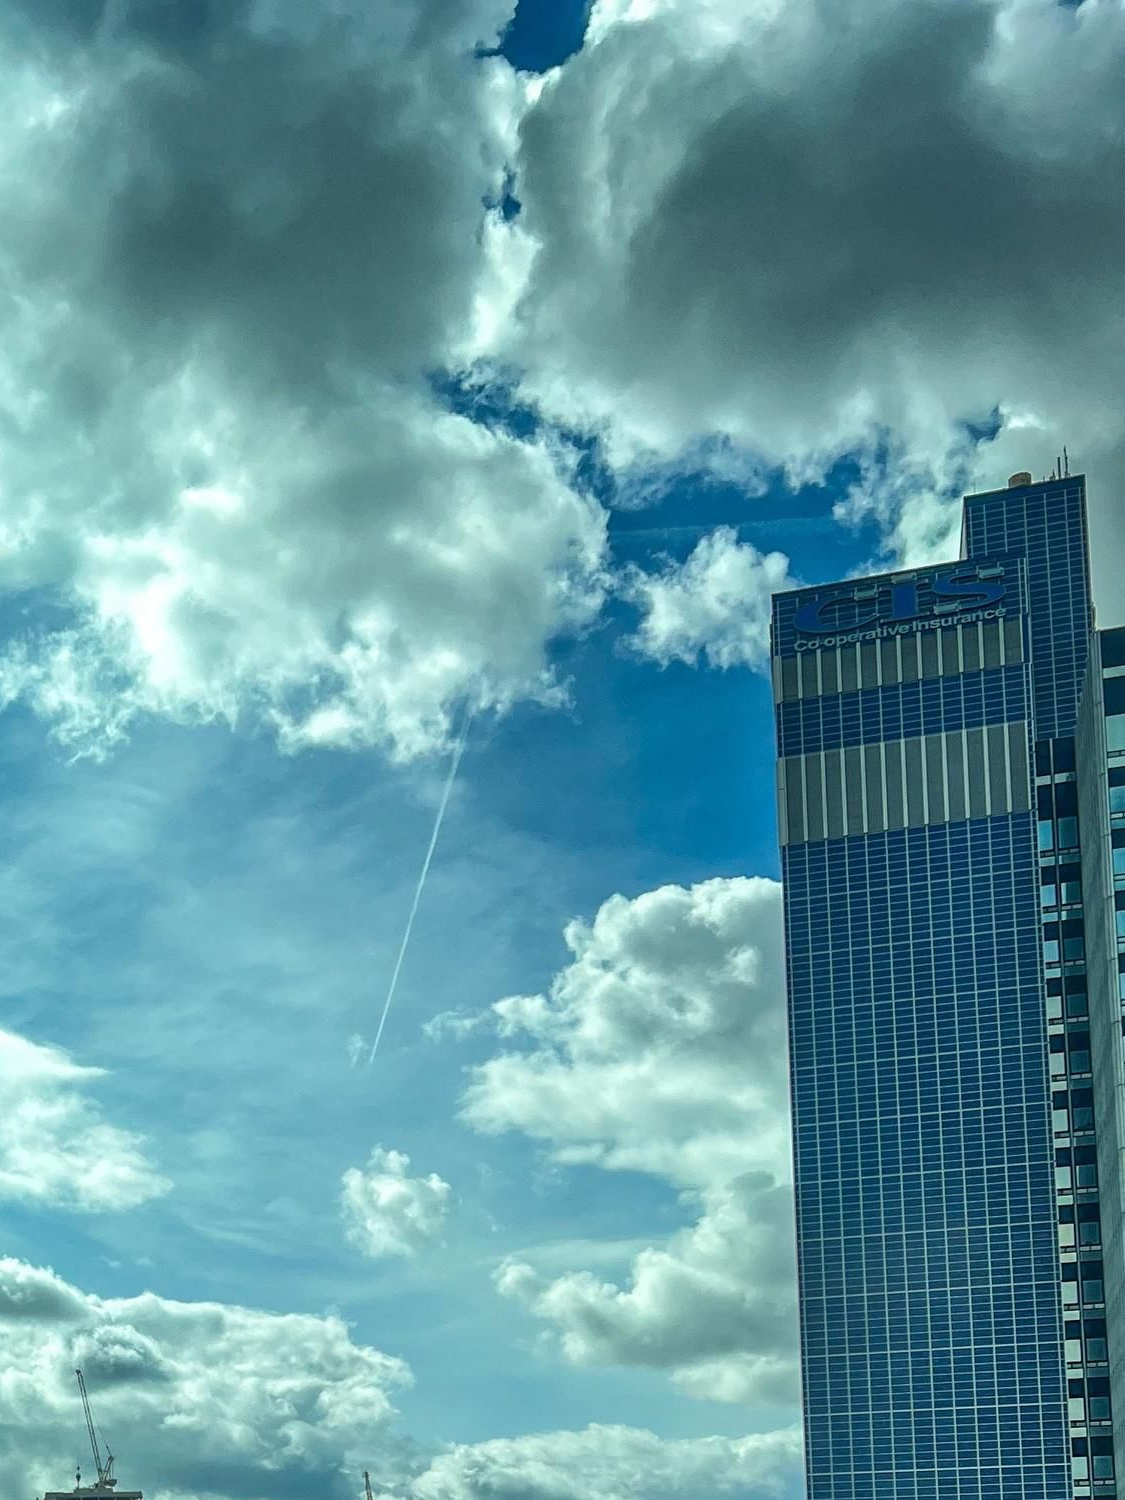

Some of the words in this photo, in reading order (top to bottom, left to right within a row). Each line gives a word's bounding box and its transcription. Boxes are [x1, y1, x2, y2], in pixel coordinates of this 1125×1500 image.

[794, 573, 1006, 633] CIS
[794, 622, 910, 652] Co-operative
[912, 606, 1007, 633] Insurance
